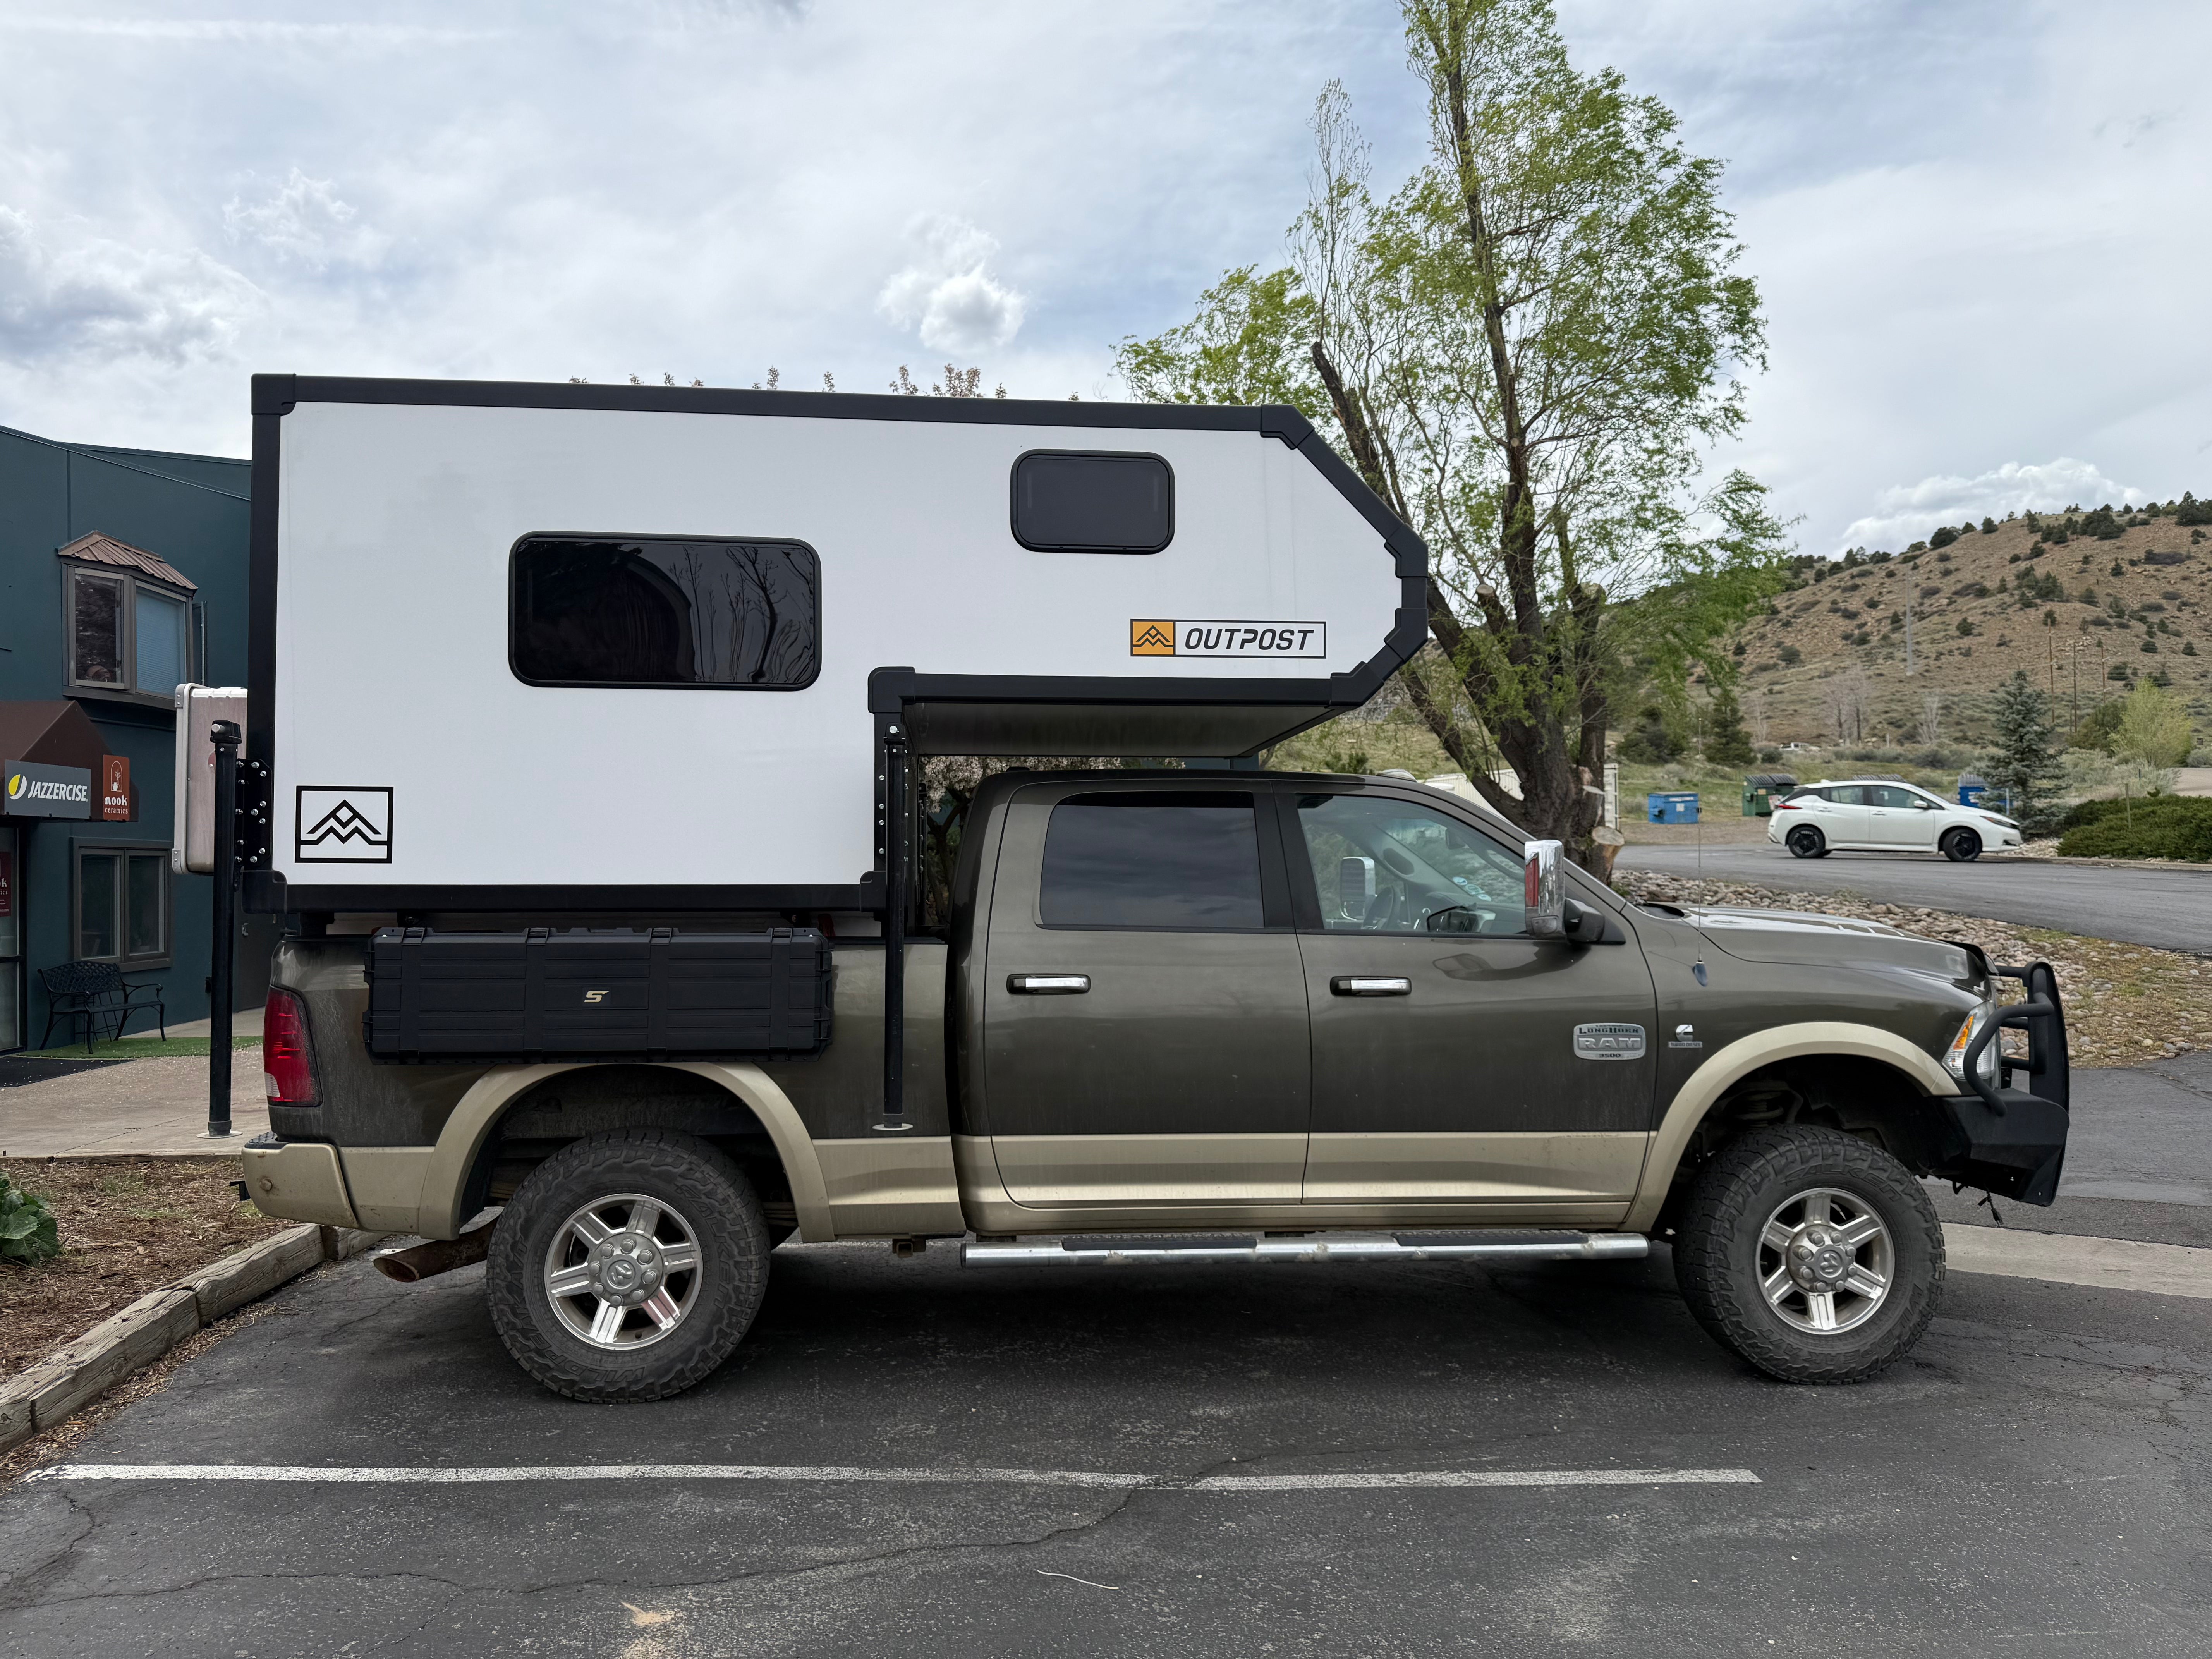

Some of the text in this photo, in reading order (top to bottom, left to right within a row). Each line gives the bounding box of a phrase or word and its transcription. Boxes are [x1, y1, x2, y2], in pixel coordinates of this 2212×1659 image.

[1185, 628, 1314, 651] OUTPOST
[27, 781, 88, 802] JAZZERCISE
[105, 794, 128, 806] nook
[1578, 1037, 1641, 1049] RAM
